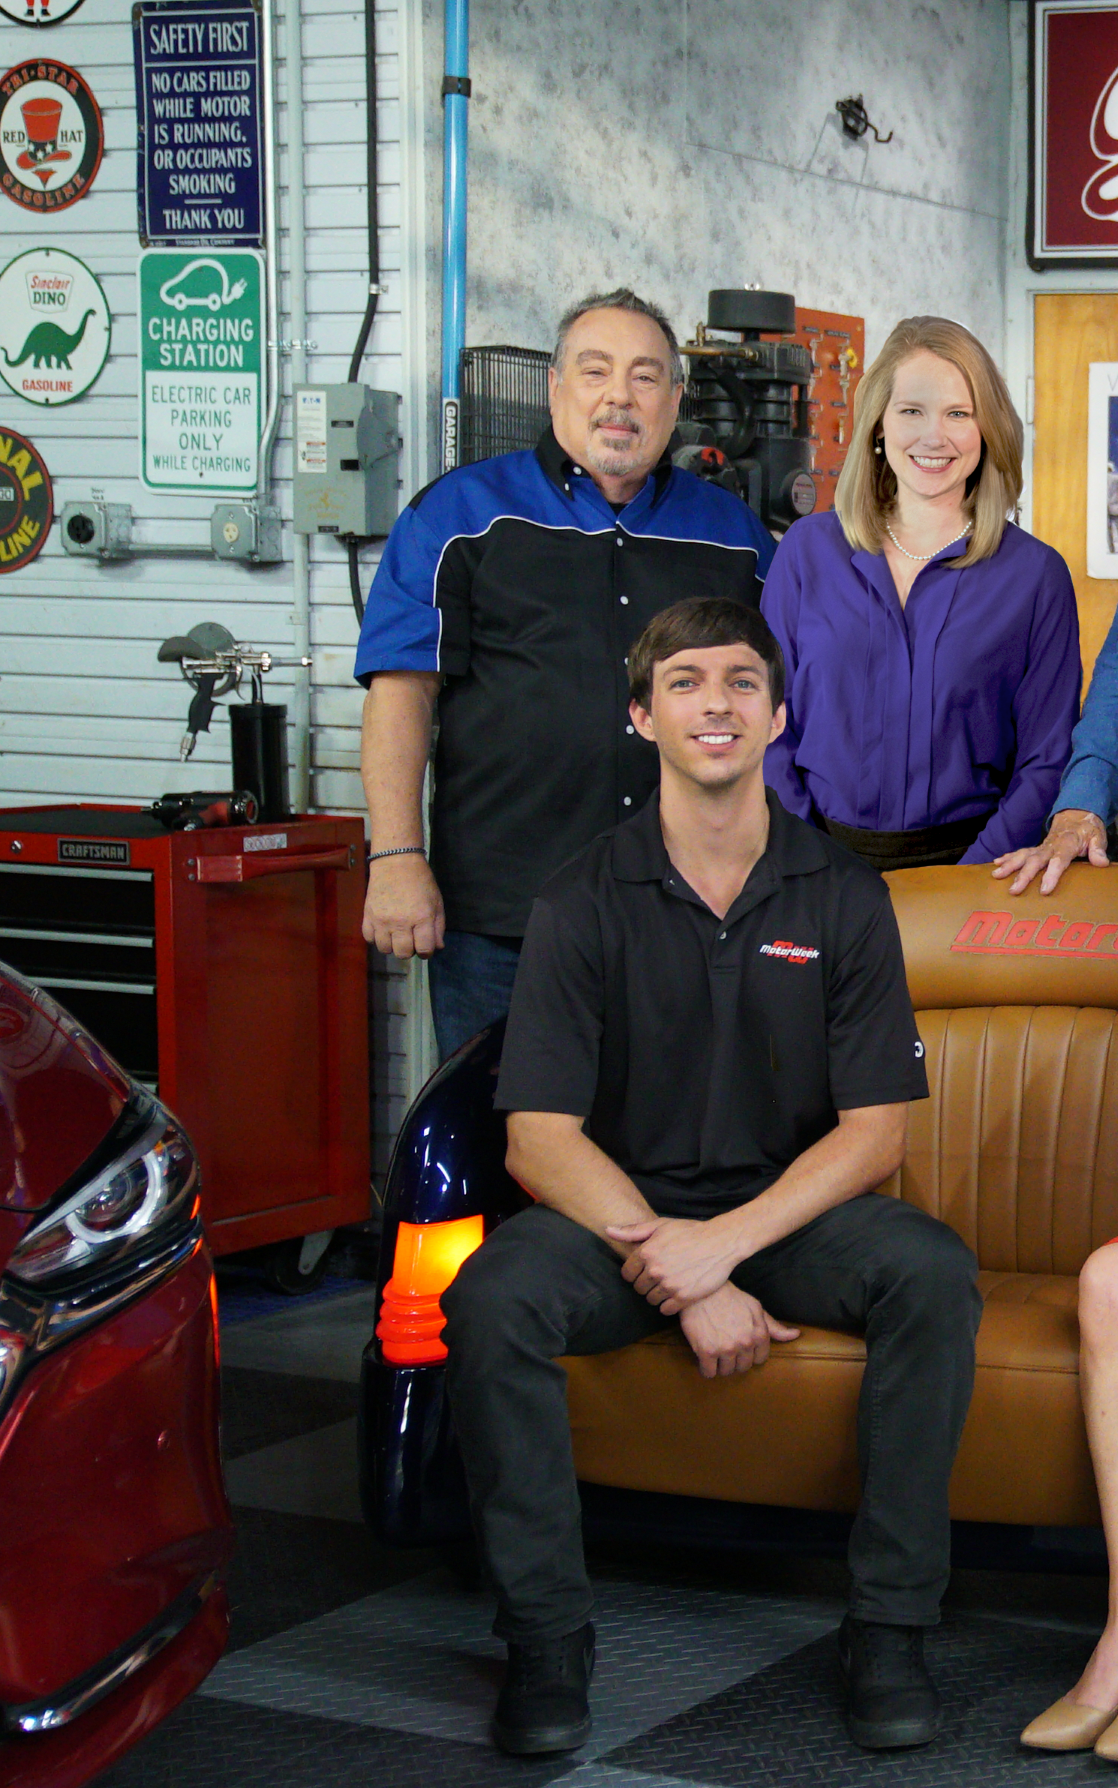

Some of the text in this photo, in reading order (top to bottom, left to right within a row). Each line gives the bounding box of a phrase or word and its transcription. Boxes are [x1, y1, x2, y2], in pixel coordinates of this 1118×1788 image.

[150, 21, 250, 55] SAFETY FIRST
[151, 70, 250, 94] NO CARS FILLED
[153, 96, 250, 119] WHILE MOTOR
[2, 129, 84, 144] RED HAT
[154, 124, 169, 144] IS
[154, 148, 252, 170] OR OCCUPANTS
[2, 172, 86, 206] GASOLINE
[169, 173, 235, 195] SMOKING
[163, 208, 245, 230] THANK YOU
[30, 275, 71, 291] Sinclair
[32, 292, 67, 306] DINO
[148, 317, 254, 341] CHARGING
[159, 344, 244, 368] STATION
[22, 378, 74, 393] GASOLINE
[151, 385, 251, 406] ELECTRIC CAR
[171, 408, 232, 429] PARKING
[179, 433, 224, 452] ONLY
[153, 455, 251, 473] WHILE CHARGING
[61, 843, 125, 860] CRAFTSMAN
[759, 944, 821, 959] MotorWeek
